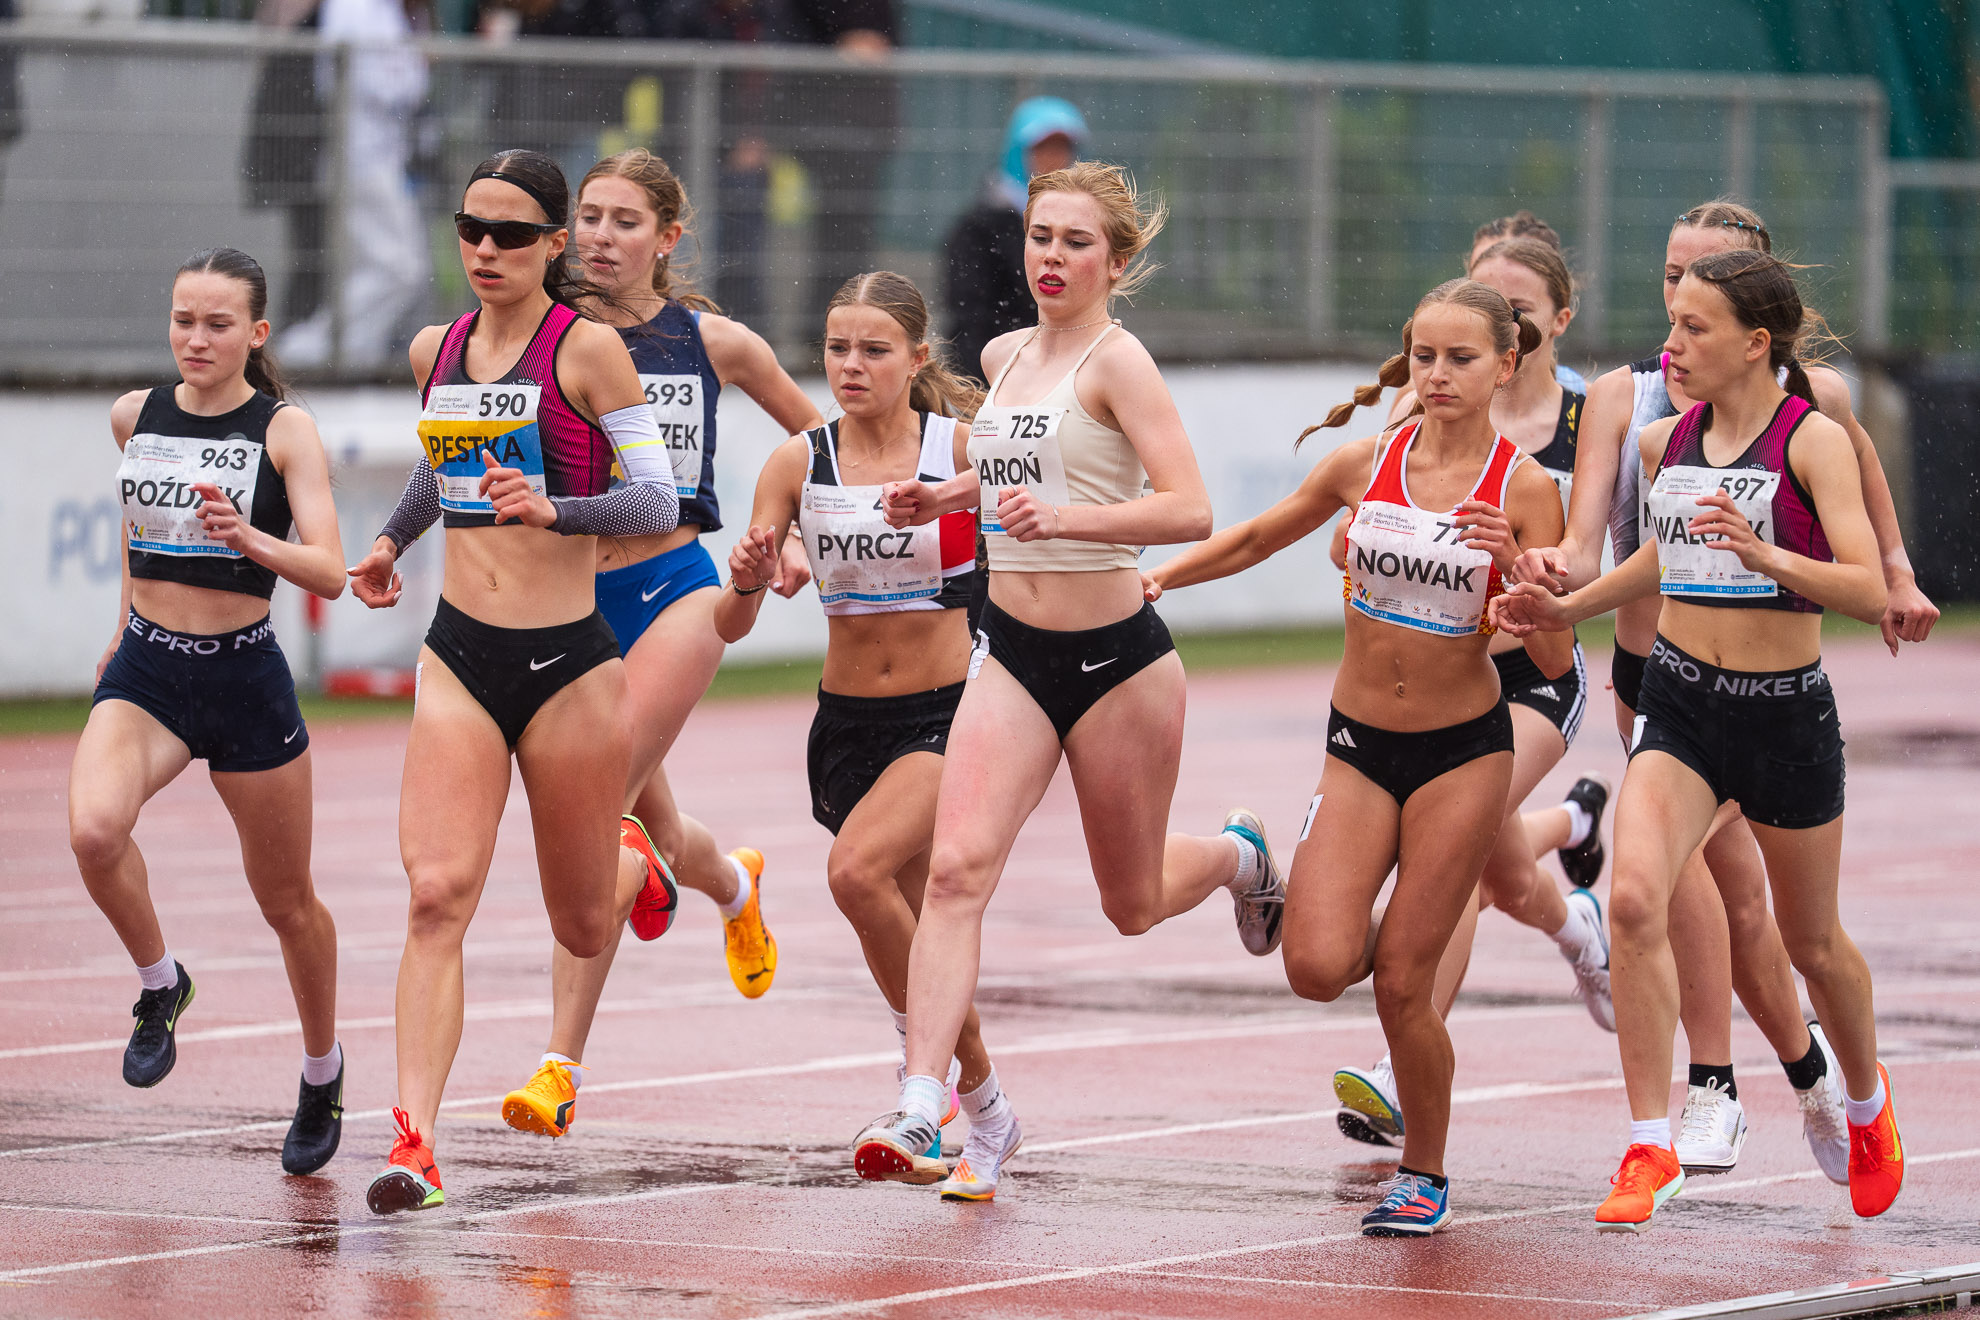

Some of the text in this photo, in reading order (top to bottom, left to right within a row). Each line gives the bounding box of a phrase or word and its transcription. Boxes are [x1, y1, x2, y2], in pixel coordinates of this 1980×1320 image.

[479, 392, 527, 417] 590
[644, 383, 693, 406] 693
[1009, 414, 1050, 439] 725
[200, 447, 248, 471] 963
[428, 435, 527, 464] PESTKA
[976, 451, 1043, 486] AROŃ
[813, 495, 846, 503] Ministerstwo
[1717, 477, 1766, 501] 597
[1373, 517, 1391, 527] Sportu
[1394, 521, 1417, 531] Turystyki
[1375, 511, 1409, 523] Ministerstwo
[818, 532, 914, 561] PYRCZ
[1356, 547, 1476, 593] NOWAK
[147, 627, 221, 655] PRO
[1649, 640, 1701, 682] PRO
[1714, 674, 1796, 697] NIKE
